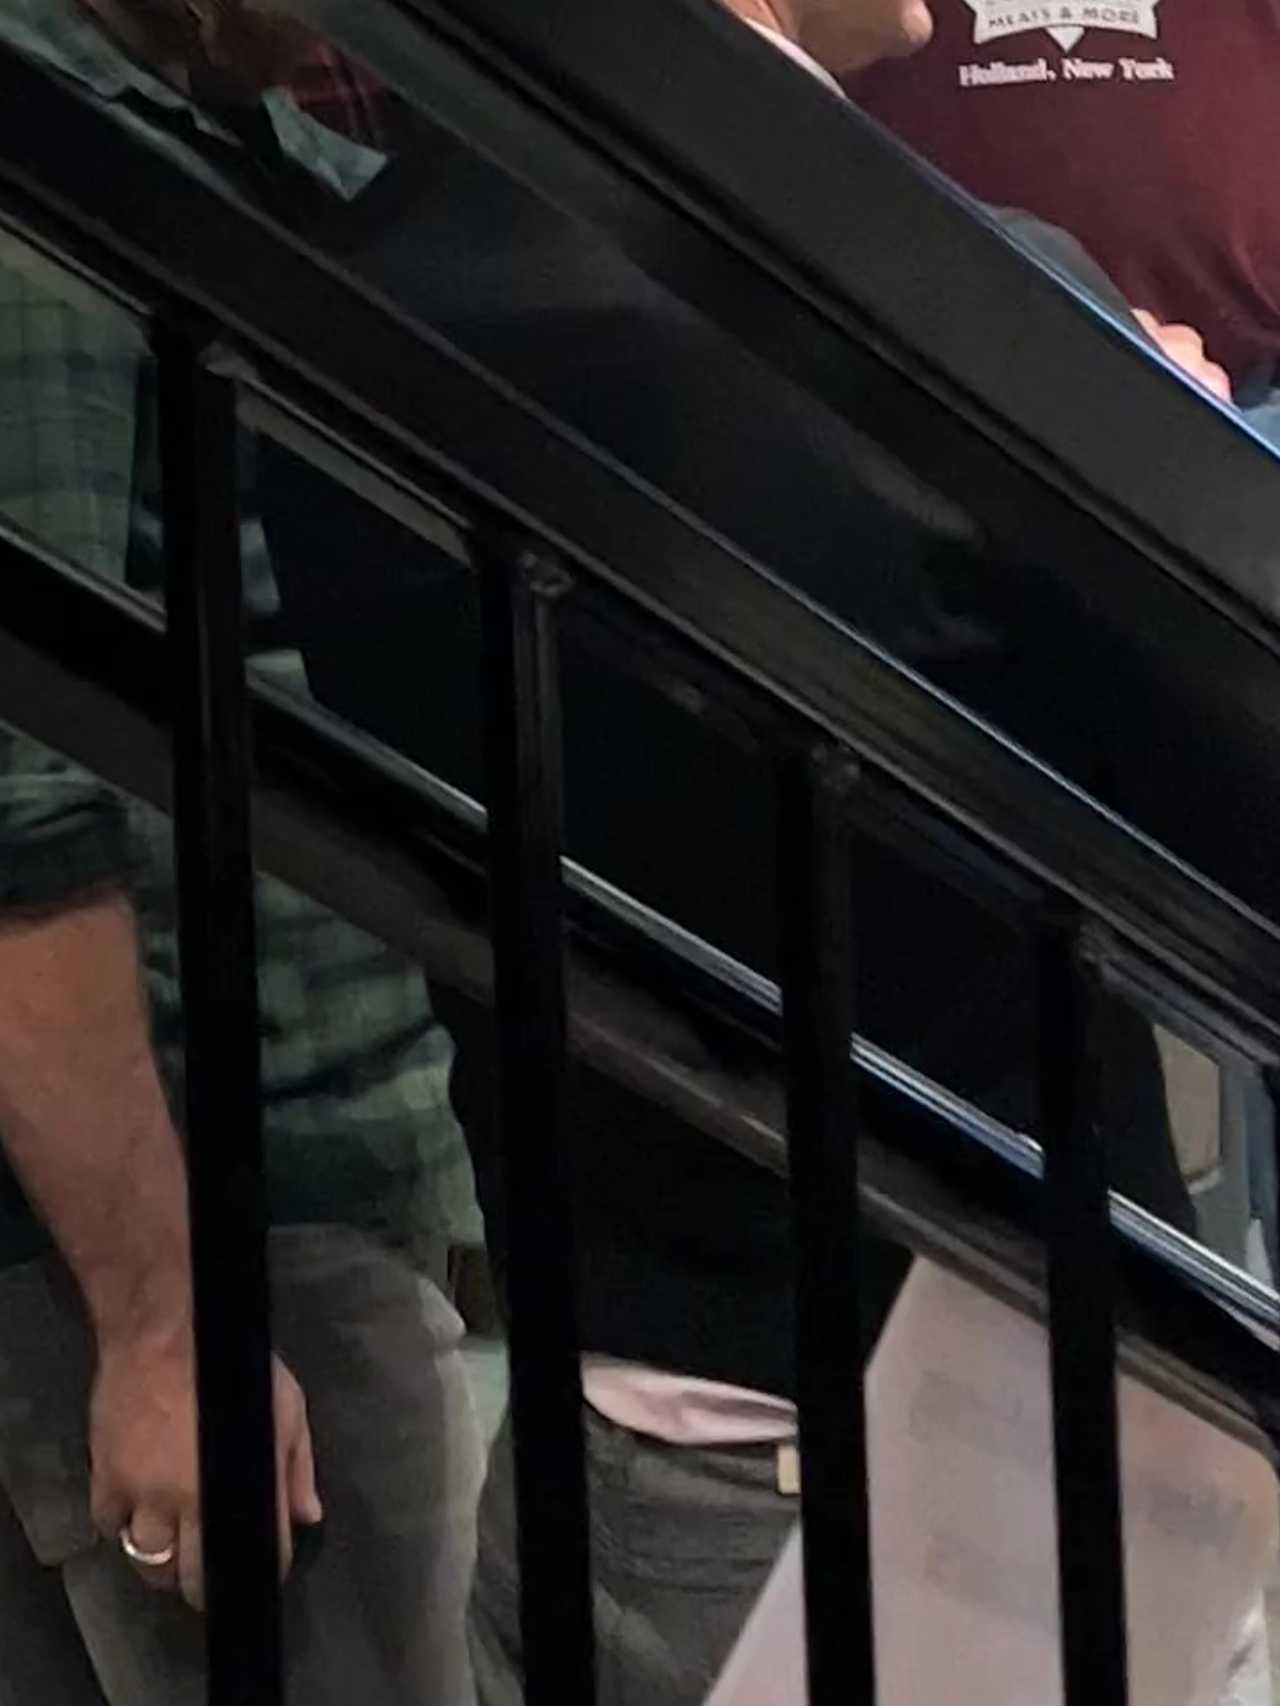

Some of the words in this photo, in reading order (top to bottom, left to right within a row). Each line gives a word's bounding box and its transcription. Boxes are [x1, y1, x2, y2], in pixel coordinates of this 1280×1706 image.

[988, 7, 1051, 29] MEATS
[1059, 5, 1073, 20] &
[1082, 6, 1141, 25] MORE
[1061, 56, 1114, 81] New
[1118, 57, 1175, 81] York
